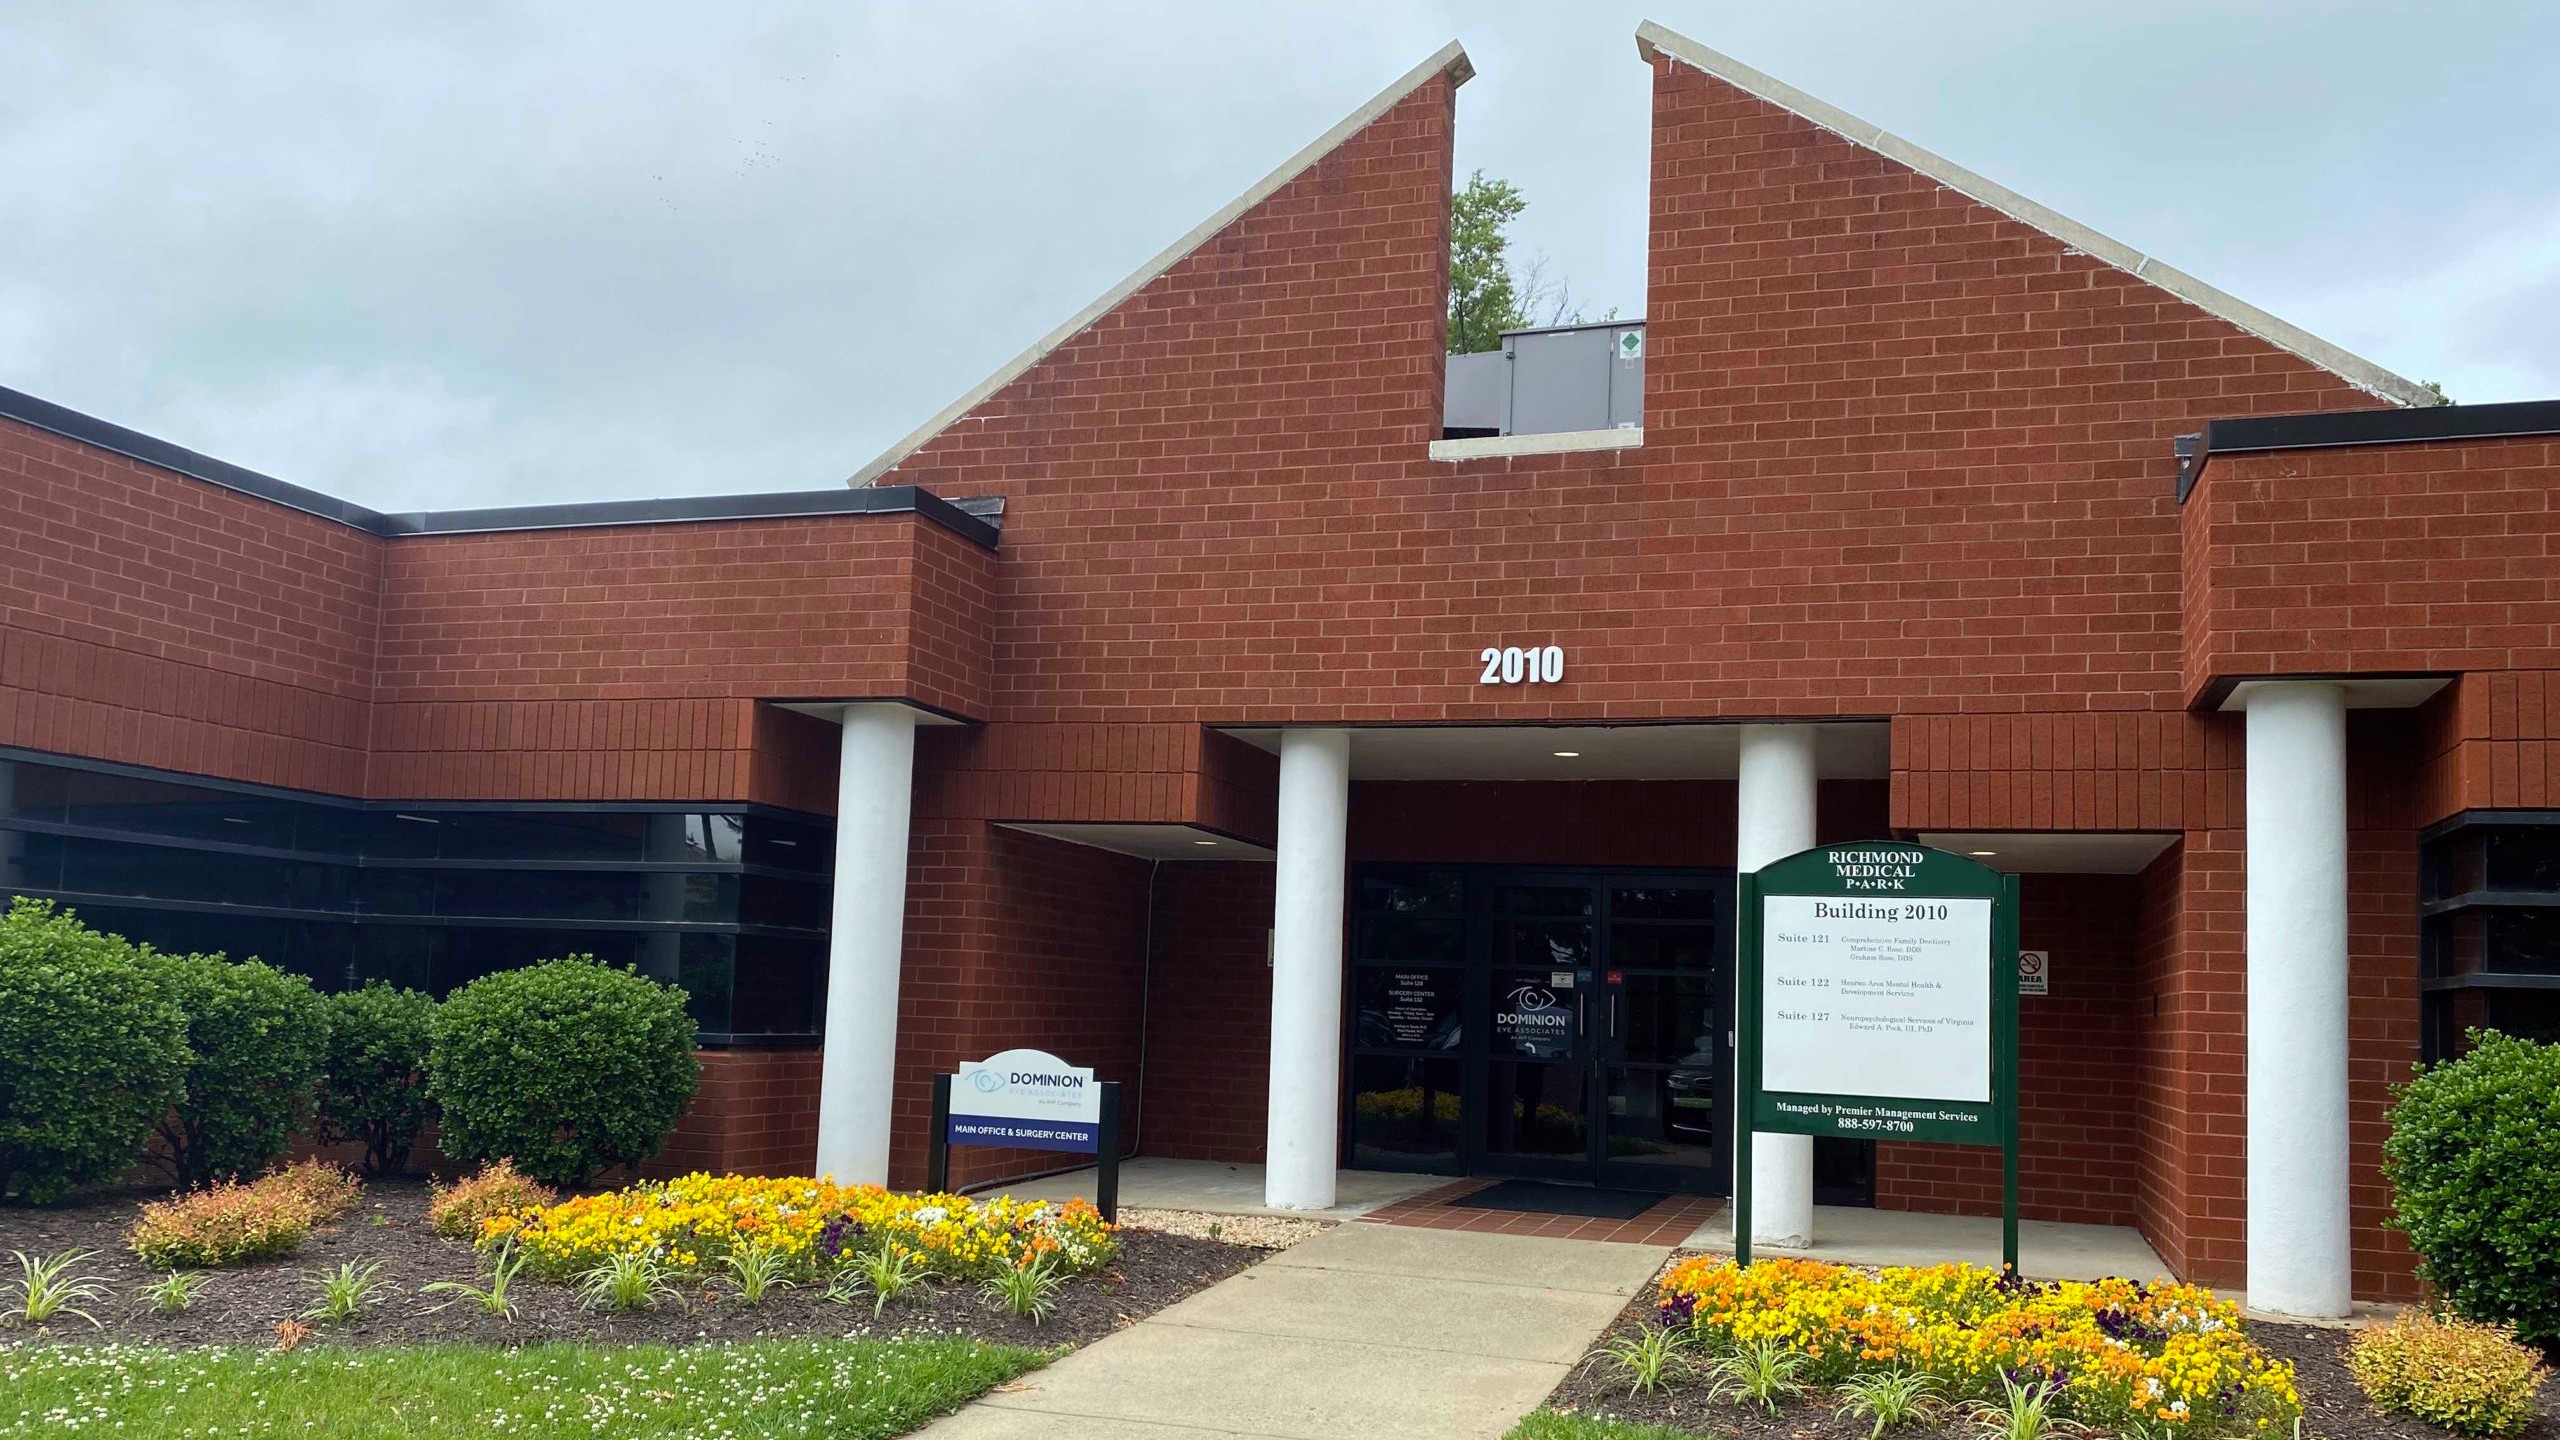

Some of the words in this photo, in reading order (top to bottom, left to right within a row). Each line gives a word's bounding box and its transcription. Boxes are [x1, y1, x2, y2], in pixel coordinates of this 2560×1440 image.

[1480, 646, 1564, 684] 2010
[1828, 851, 1924, 864] RICHMOND
[1836, 865, 1916, 878] MEDICAL
[1814, 902, 1899, 923] Building
[1904, 904, 1948, 921] 2010
[1778, 933, 1808, 943] Suite
[1811, 934, 1830, 943] 121
[1894, 937, 1917, 945] Family
[1777, 977, 1807, 986] Suite
[1811, 978, 1830, 987] 122
[1911, 981, 1934, 989] Health
[1497, 1013, 1566, 1027] DOMINION
[1777, 1011, 1807, 1020] Suite
[1811, 1012, 1830, 1021] 127
[1515, 1027, 1566, 1036] ASSOCIATES
[1010, 1072, 1083, 1088] DOMINION
[1776, 1102, 1819, 1115] Managed
[1821, 1104, 1833, 1117] by
[1835, 1105, 1873, 1117] Premier
[1875, 1107, 1936, 1120] Management
[1938, 1110, 1978, 1122] Services
[1837, 1117, 1914, 1133] 888-597-8700
[955, 1125, 976, 1134] MAIN
[977, 1126, 1006, 1136] OFFICE
[1007, 1128, 1014, 1136] &
[1016, 1129, 1054, 1139] SURGERY
[1055, 1131, 1089, 1142] CENTER
